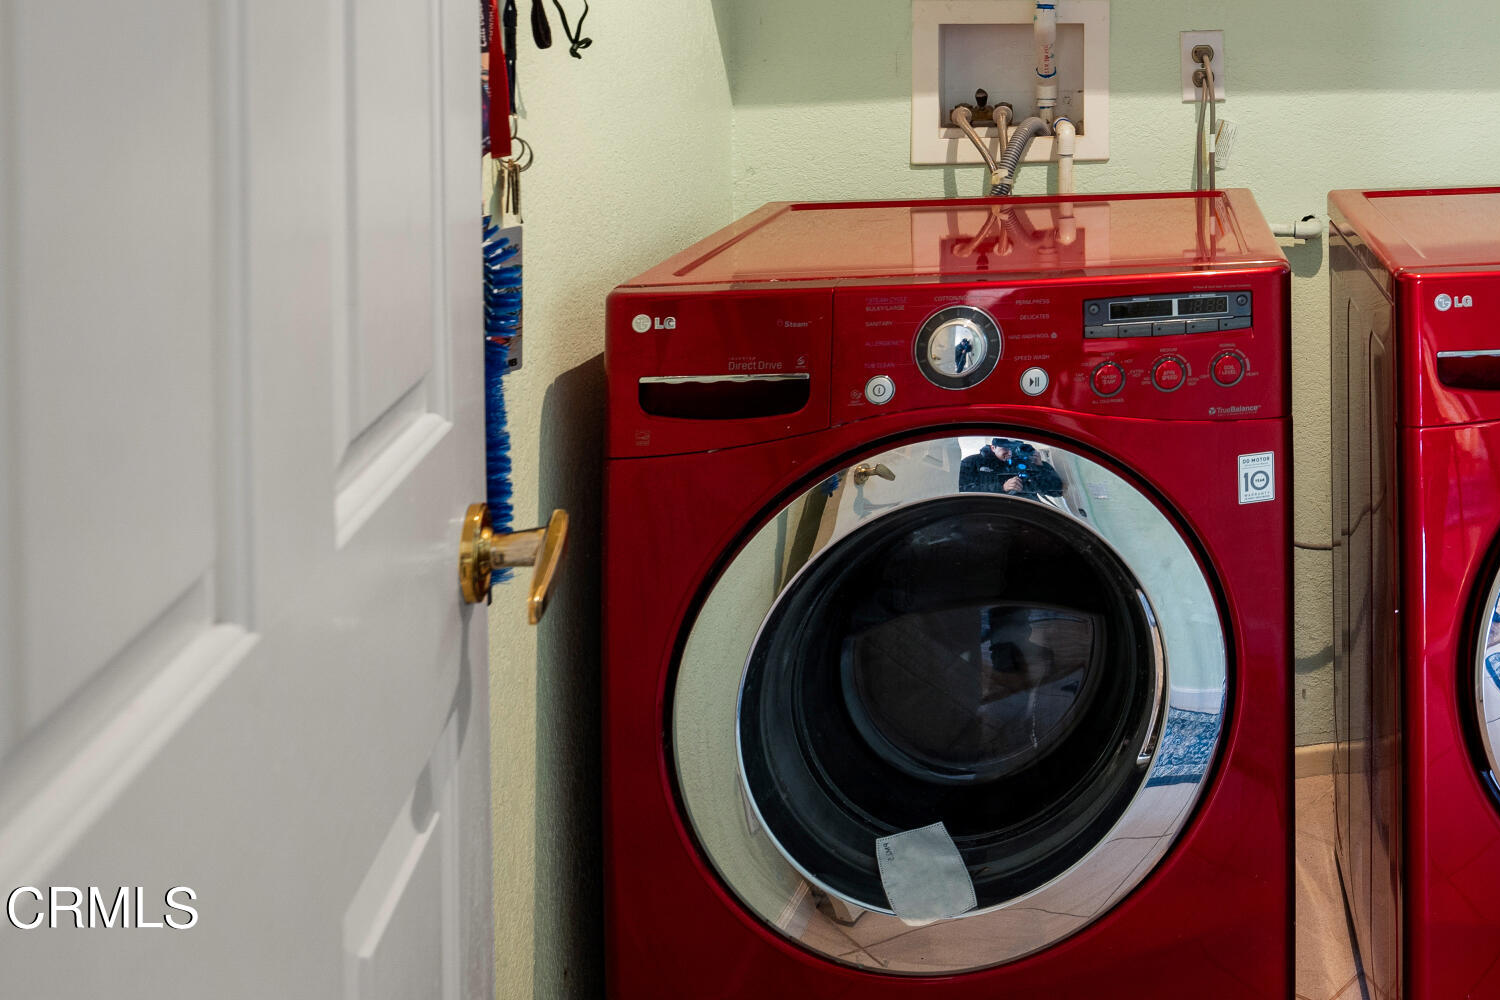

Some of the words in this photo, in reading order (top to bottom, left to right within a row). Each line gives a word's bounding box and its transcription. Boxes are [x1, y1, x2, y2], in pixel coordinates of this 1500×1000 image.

[1454, 295, 1473, 307] LG
[654, 317, 676, 329] LG
[728, 361, 756, 371] Direct
[758, 360, 782, 370] Drive
[1244, 470, 1270, 492] 10
